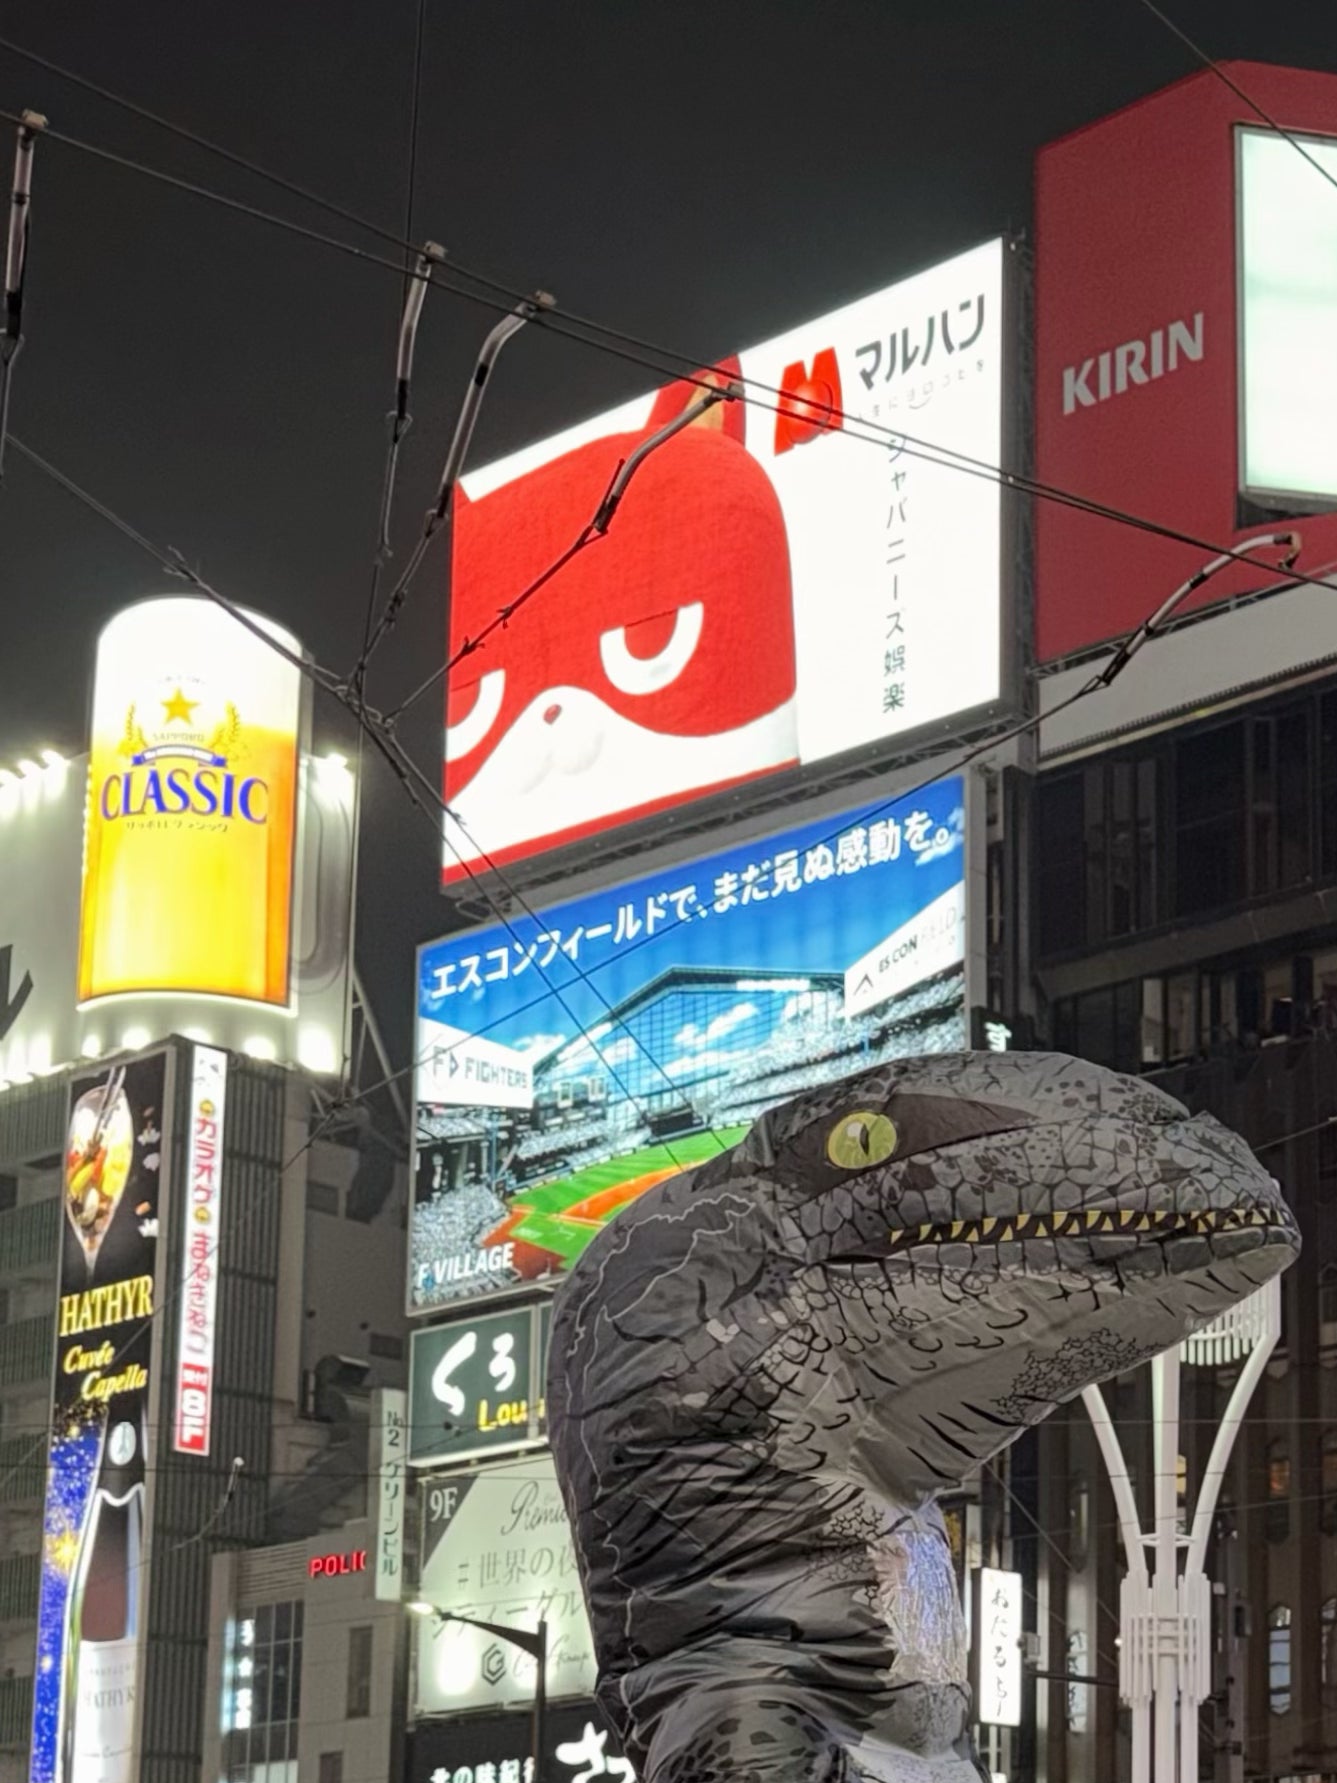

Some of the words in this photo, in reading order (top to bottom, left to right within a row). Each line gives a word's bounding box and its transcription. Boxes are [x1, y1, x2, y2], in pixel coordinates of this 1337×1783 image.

[854, 293, 986, 391] マルハン
[1061, 312, 1206, 416] KIRIN
[101, 767, 269, 825] CLASSIC
[431, 810, 950, 1000] エスコンフィールドで、まだ見ぬ感動を。
[464, 1056, 528, 1089] FIGHTERS
[433, 1241, 515, 1282] VILLAGE
[59, 1273, 154, 1338] HATHYR
[80, 1365, 148, 1404] Capella
[429, 1486, 459, 1523] 9F
